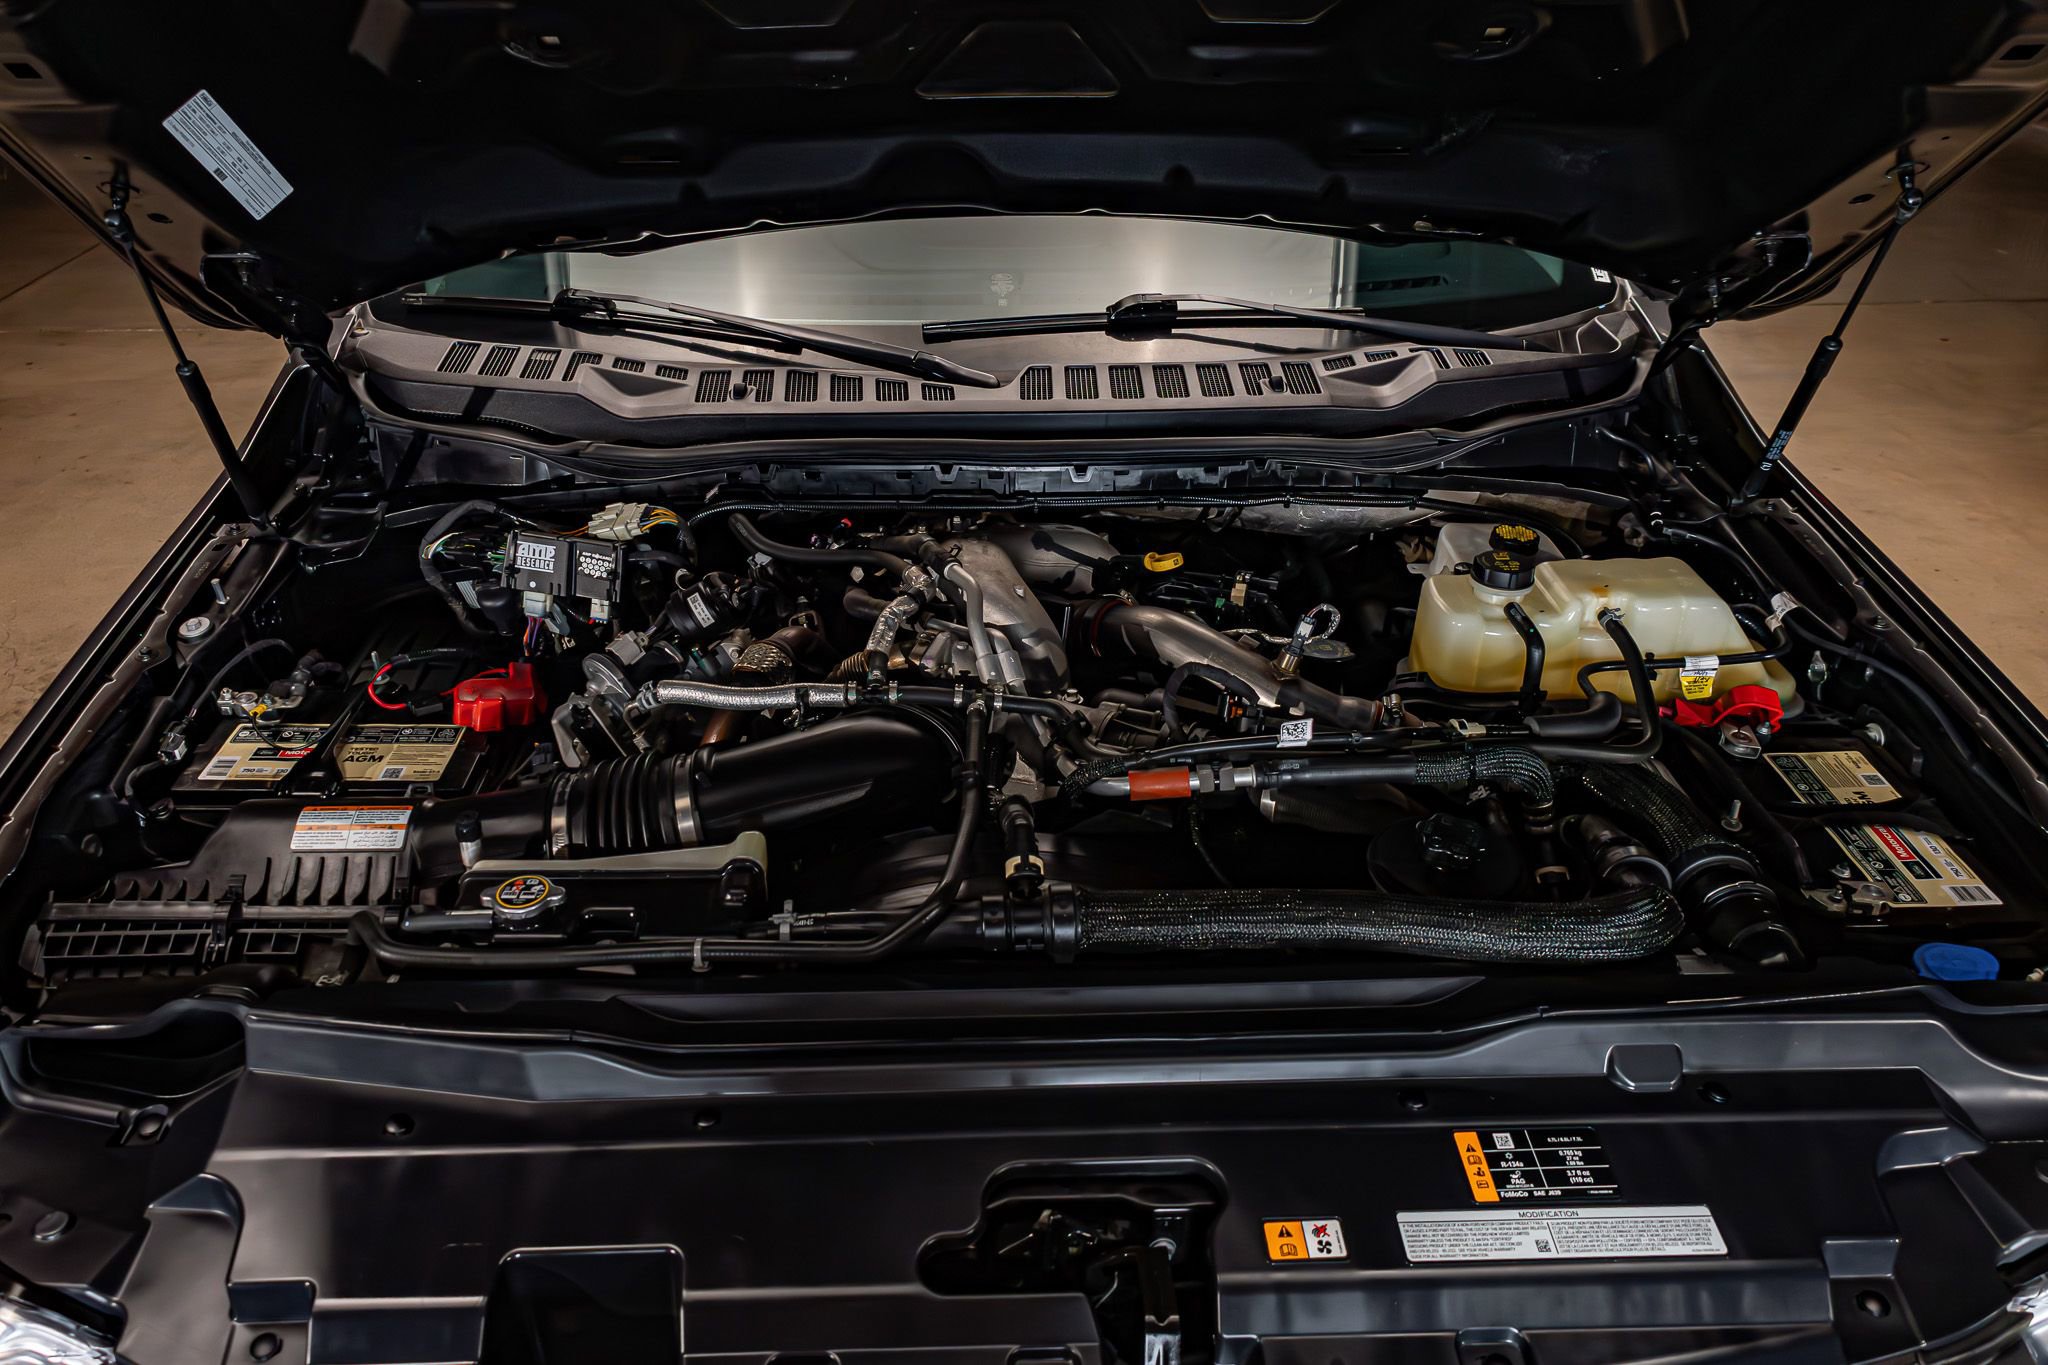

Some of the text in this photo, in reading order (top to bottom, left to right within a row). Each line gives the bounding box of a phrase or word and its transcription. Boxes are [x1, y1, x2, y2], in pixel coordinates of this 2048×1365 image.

[517, 544, 556, 560] AMP
[517, 556, 554, 570] RESEARCH
[342, 754, 385, 763] AGM
